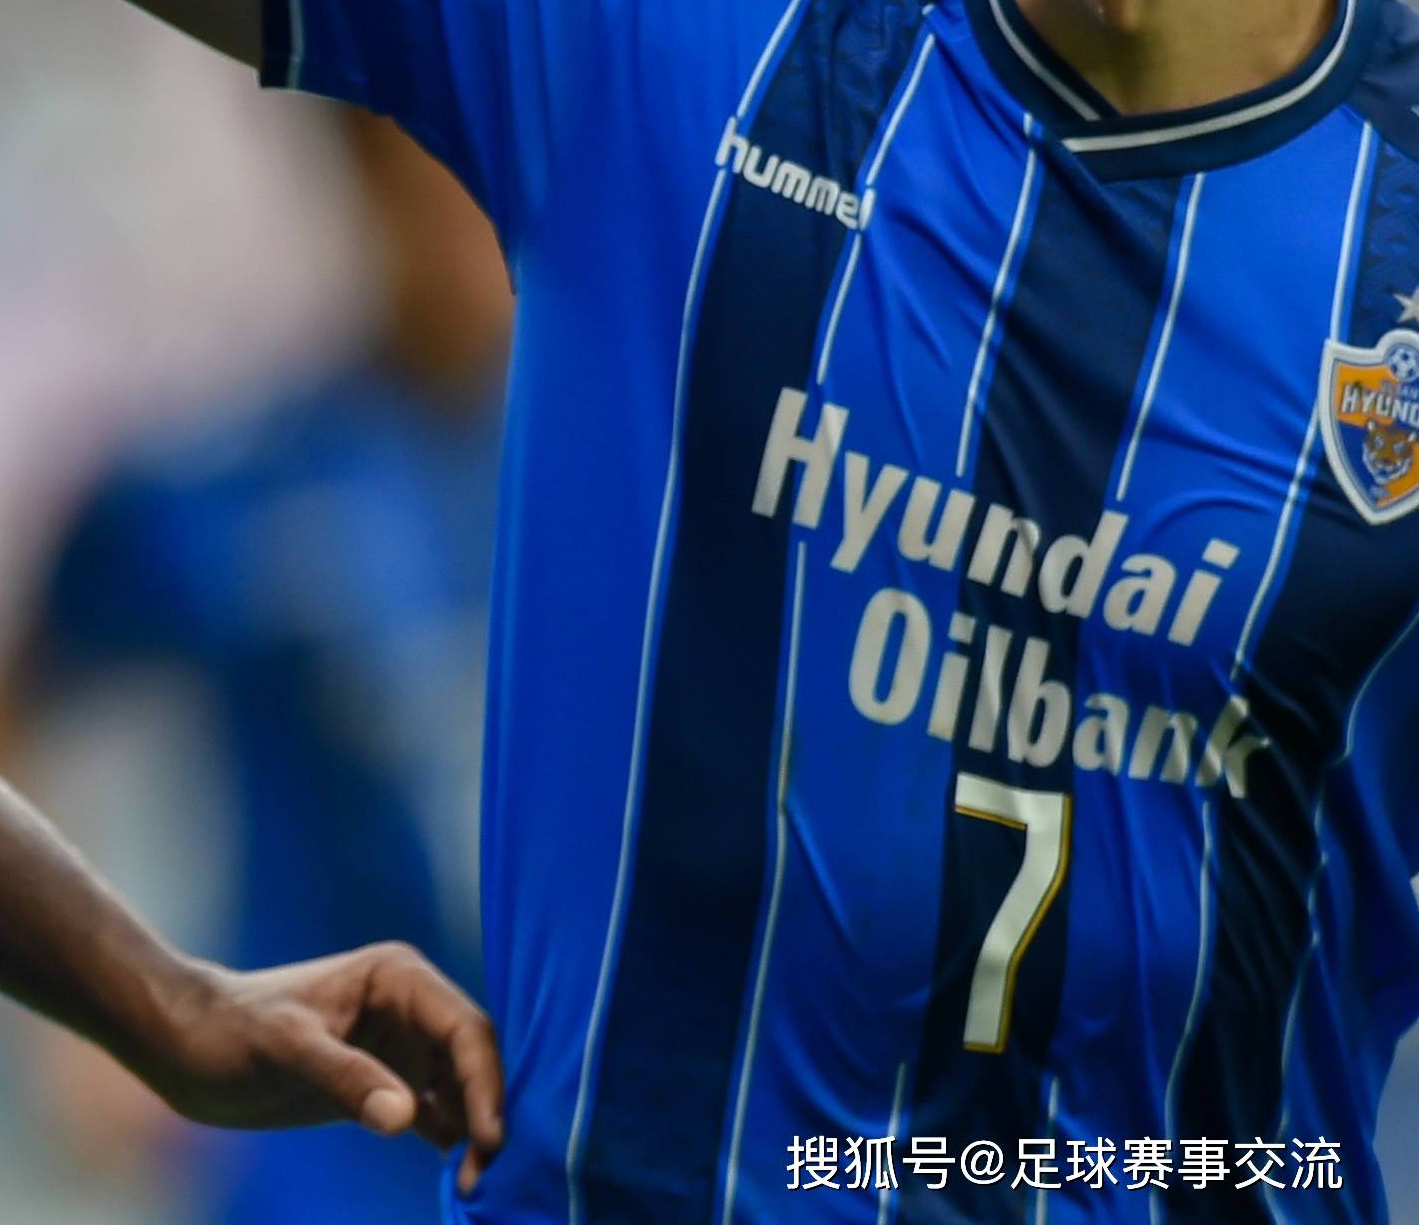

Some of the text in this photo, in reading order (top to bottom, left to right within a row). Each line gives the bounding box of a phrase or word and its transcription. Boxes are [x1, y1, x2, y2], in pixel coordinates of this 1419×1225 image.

[714, 116, 876, 231] hummel
[751, 387, 1240, 646] Hyundai
[848, 587, 1271, 800] Oilbank
[954, 772, 1073, 1053] 7
